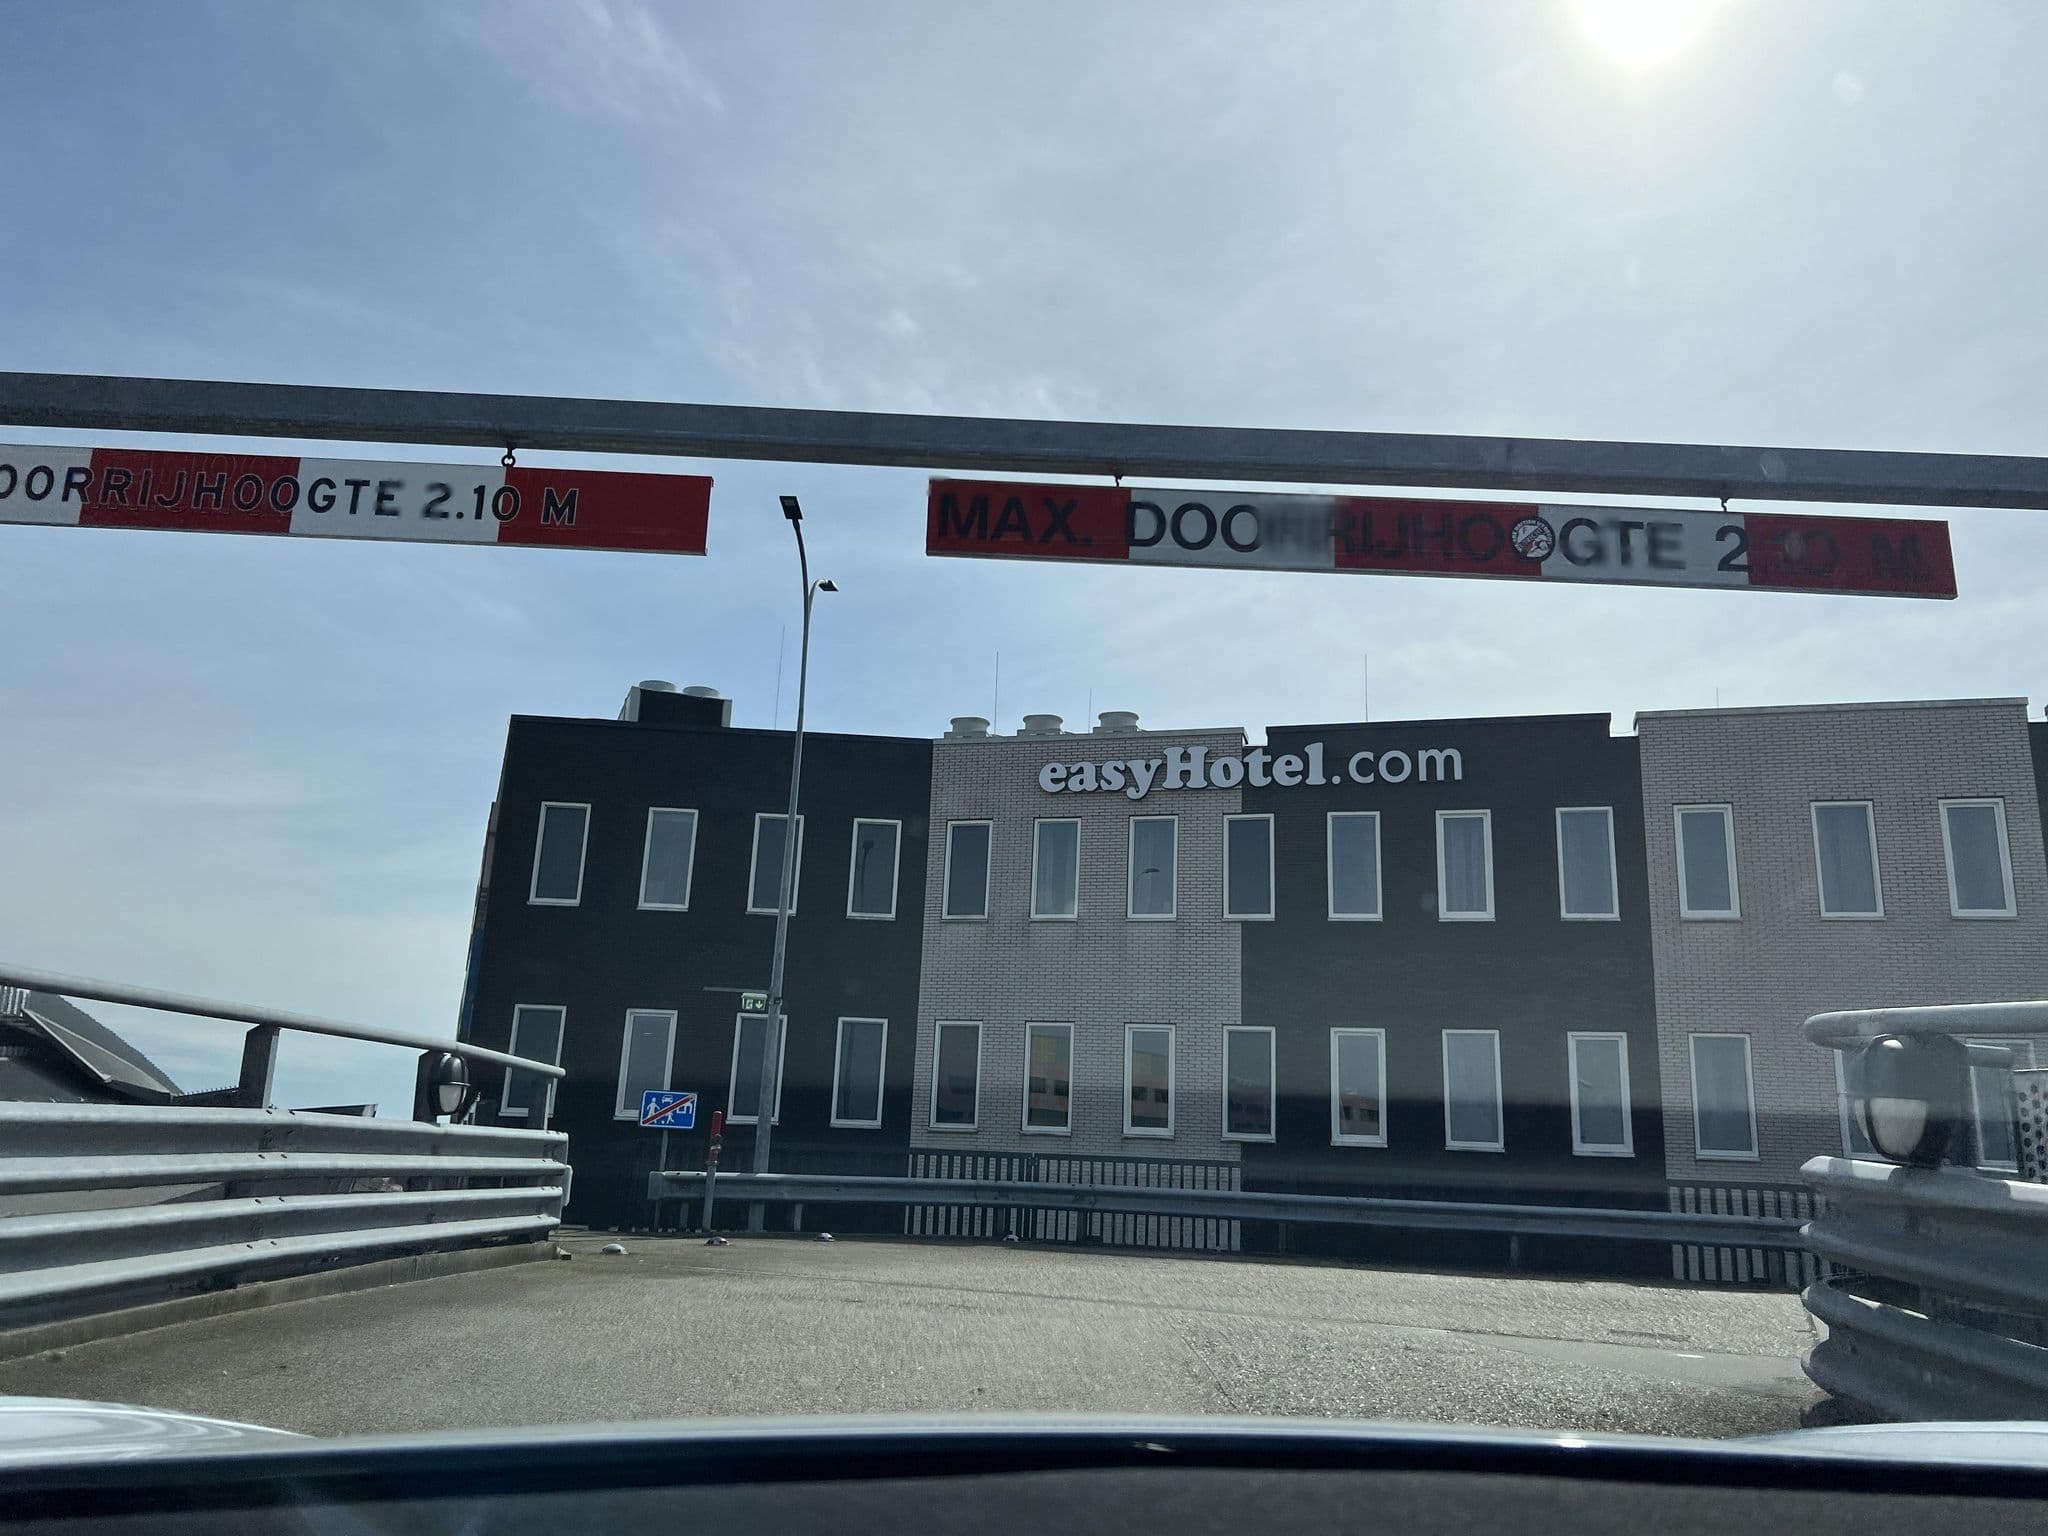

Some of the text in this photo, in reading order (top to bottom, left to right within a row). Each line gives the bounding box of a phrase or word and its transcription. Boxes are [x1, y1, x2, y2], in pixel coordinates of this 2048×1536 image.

[423, 482, 521, 522] 2.10
[541, 487, 579, 525] M
[938, 492, 1093, 547] MAX.
[1038, 742, 1464, 800] easyHotel.com
